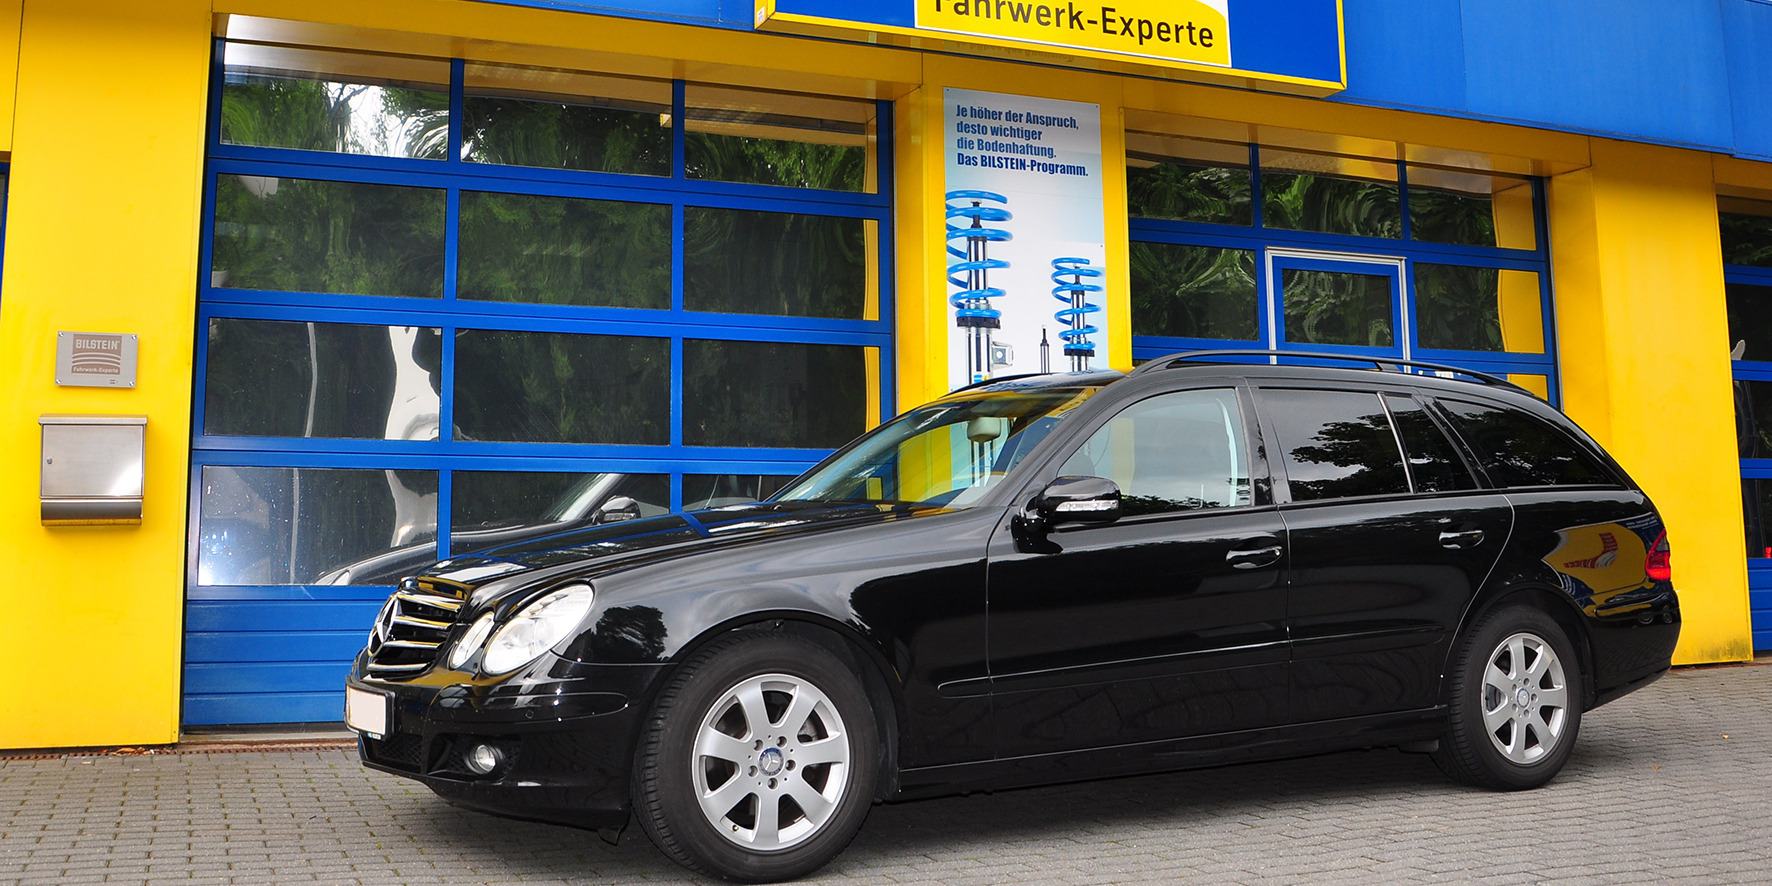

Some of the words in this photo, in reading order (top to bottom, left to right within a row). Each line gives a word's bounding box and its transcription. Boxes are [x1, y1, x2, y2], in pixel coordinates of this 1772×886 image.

[956, 104, 968, 118] Je
[970, 105, 1003, 121] höher
[1005, 109, 1024, 124] der
[1025, 111, 1079, 131] Anspruch,
[956, 120, 988, 136] desto
[990, 124, 1043, 141] wichtiger
[956, 136, 975, 151] die
[977, 138, 1057, 159] Bodenhaftung.
[957, 152, 978, 167] Das
[980, 155, 1089, 177] BILSTEIN-Programm.
[75, 339, 119, 350] BILSTEIN
